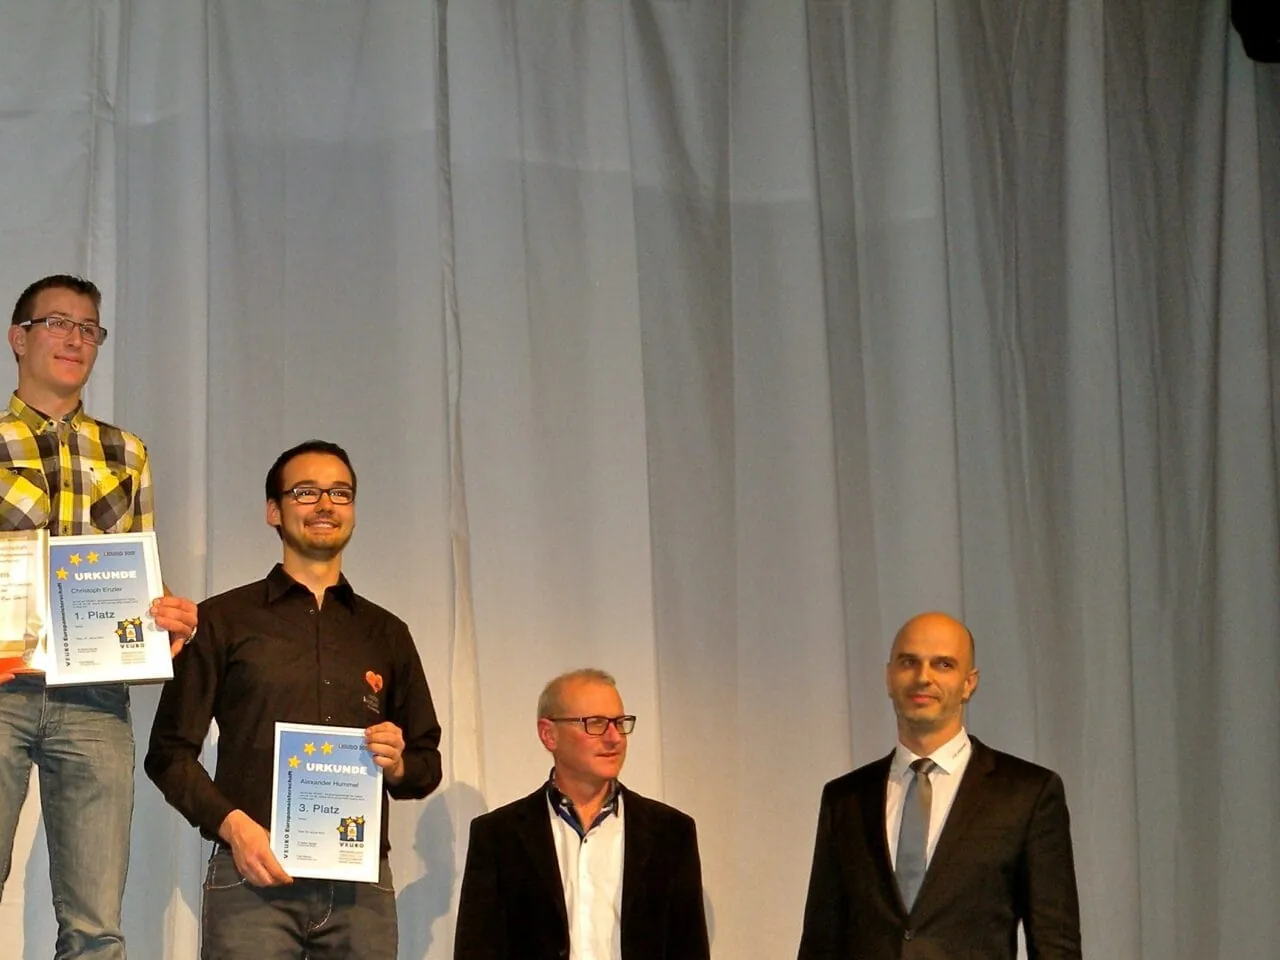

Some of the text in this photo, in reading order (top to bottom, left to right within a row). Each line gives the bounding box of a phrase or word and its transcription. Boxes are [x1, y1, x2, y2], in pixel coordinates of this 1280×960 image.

[74, 570, 137, 581] URKUNDE
[71, 586, 102, 596] Christoph
[74, 610, 116, 620] 1. Platz
[306, 762, 368, 775] URKUNDE
[300, 778, 359, 788] Alexander Hummel
[298, 804, 340, 815] 3. Platz
